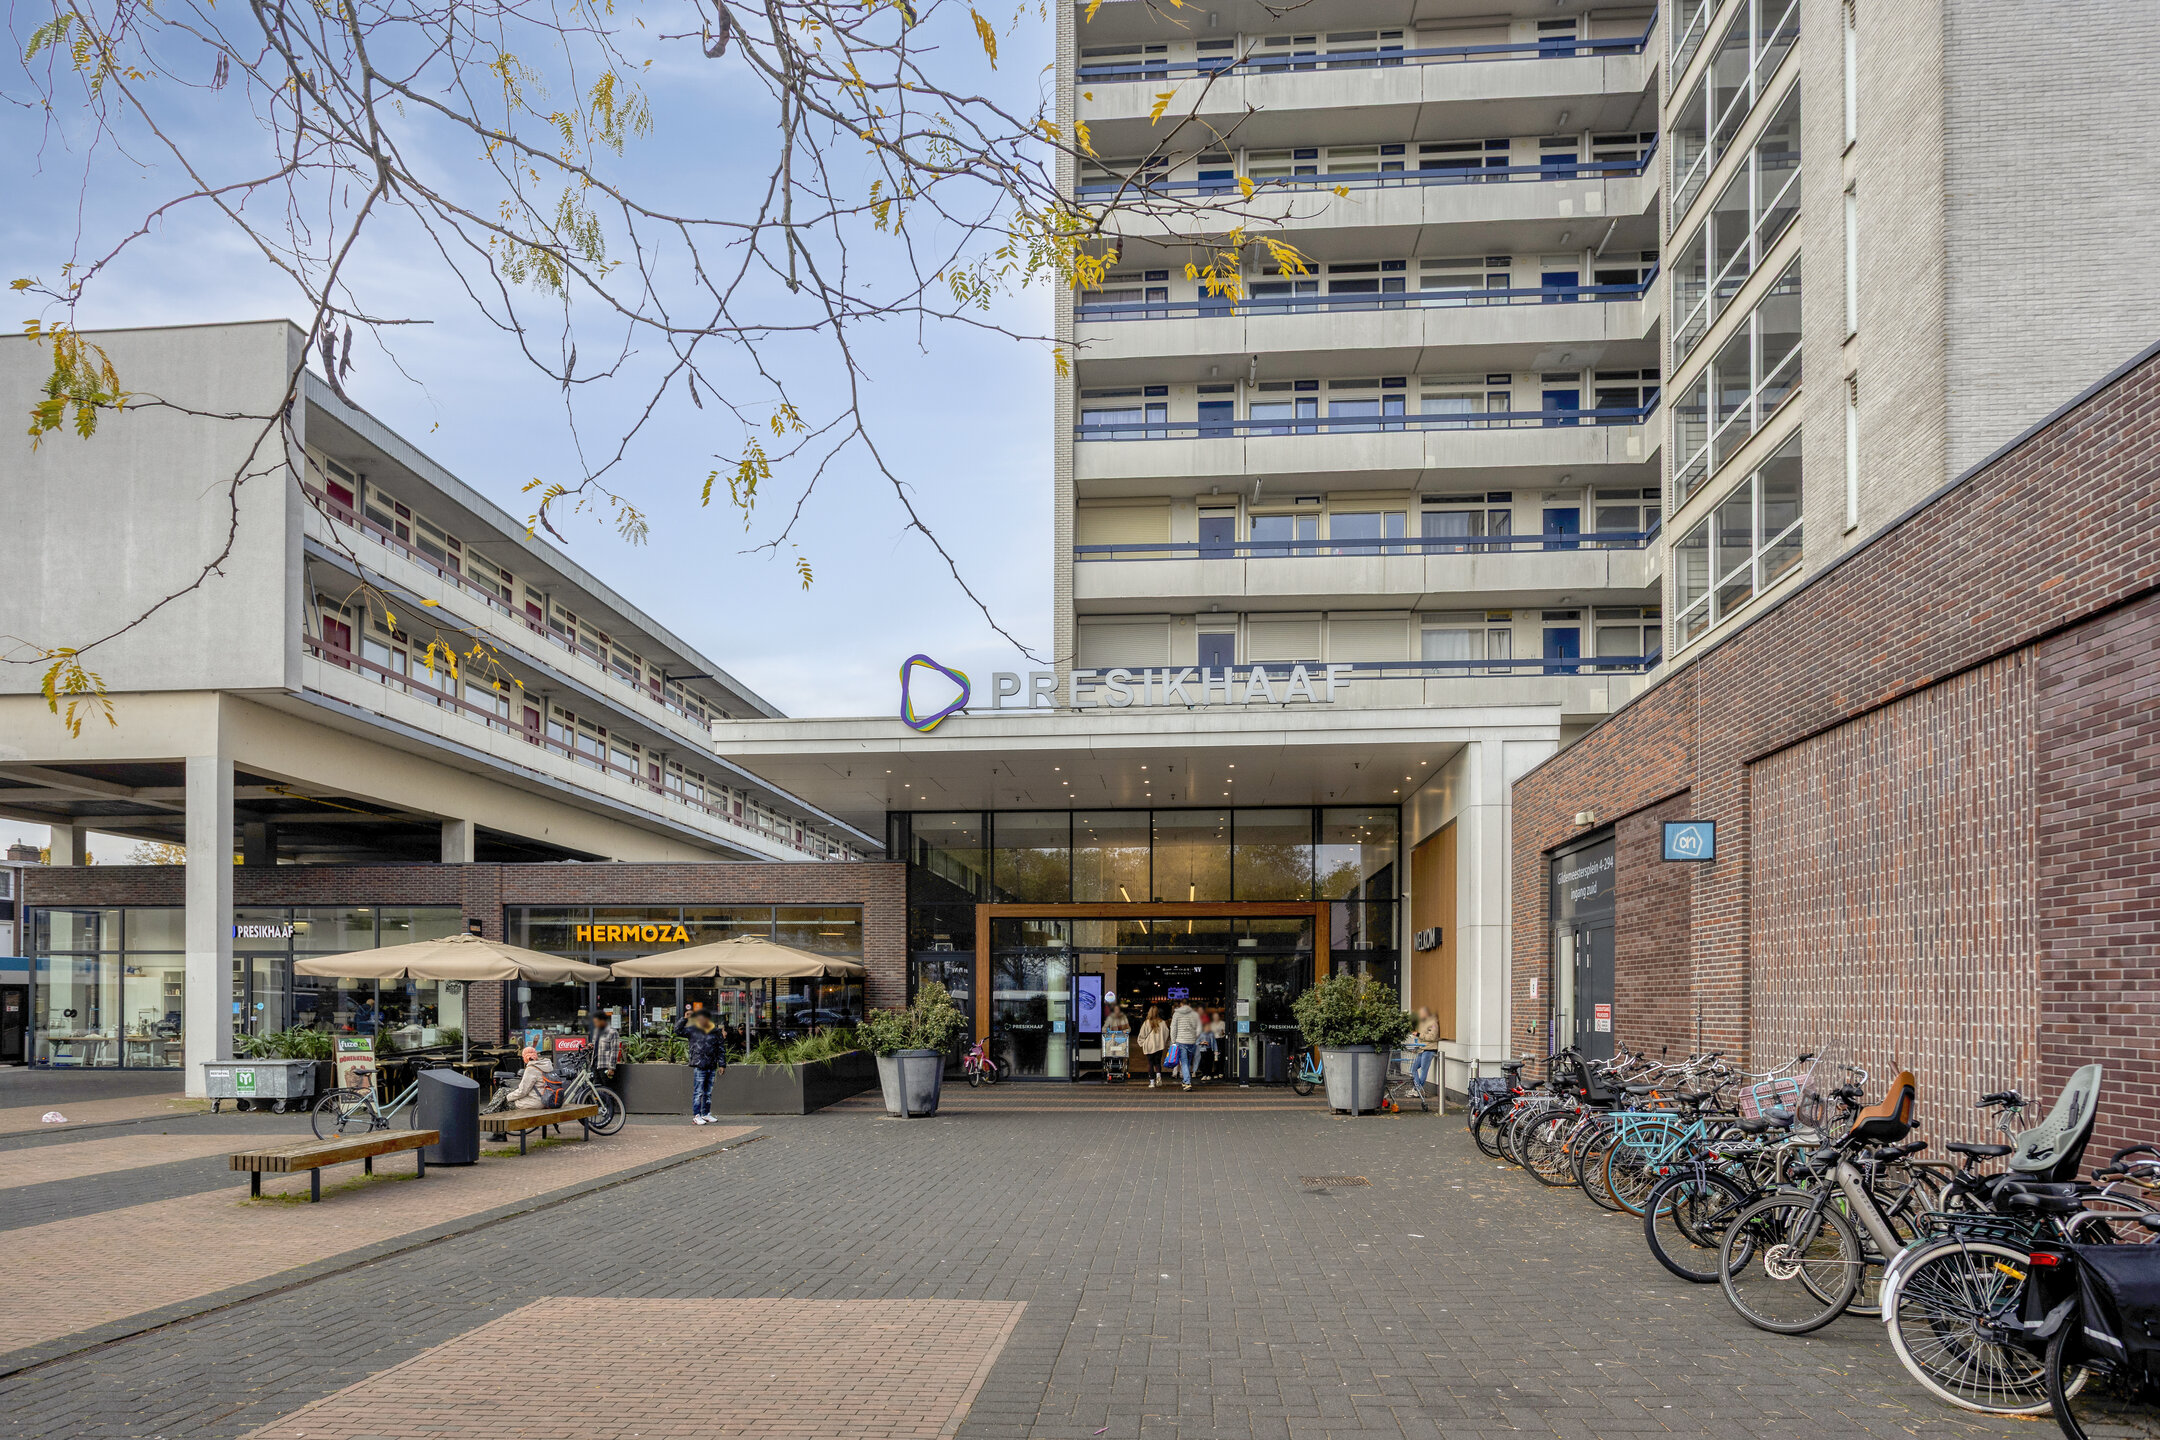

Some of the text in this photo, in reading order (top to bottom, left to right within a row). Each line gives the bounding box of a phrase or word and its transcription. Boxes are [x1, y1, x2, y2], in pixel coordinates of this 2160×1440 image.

[992, 664, 1353, 709] PRESIKHAAF
[1557, 856, 1614, 885] Gildemeestersplein 4-294
[1571, 881, 1597, 902] ingang zuid
[238, 925, 293, 938] PRESIKHAAF
[577, 925, 690, 942] HERMOZA
[1414, 927, 1437, 952] WELKOM
